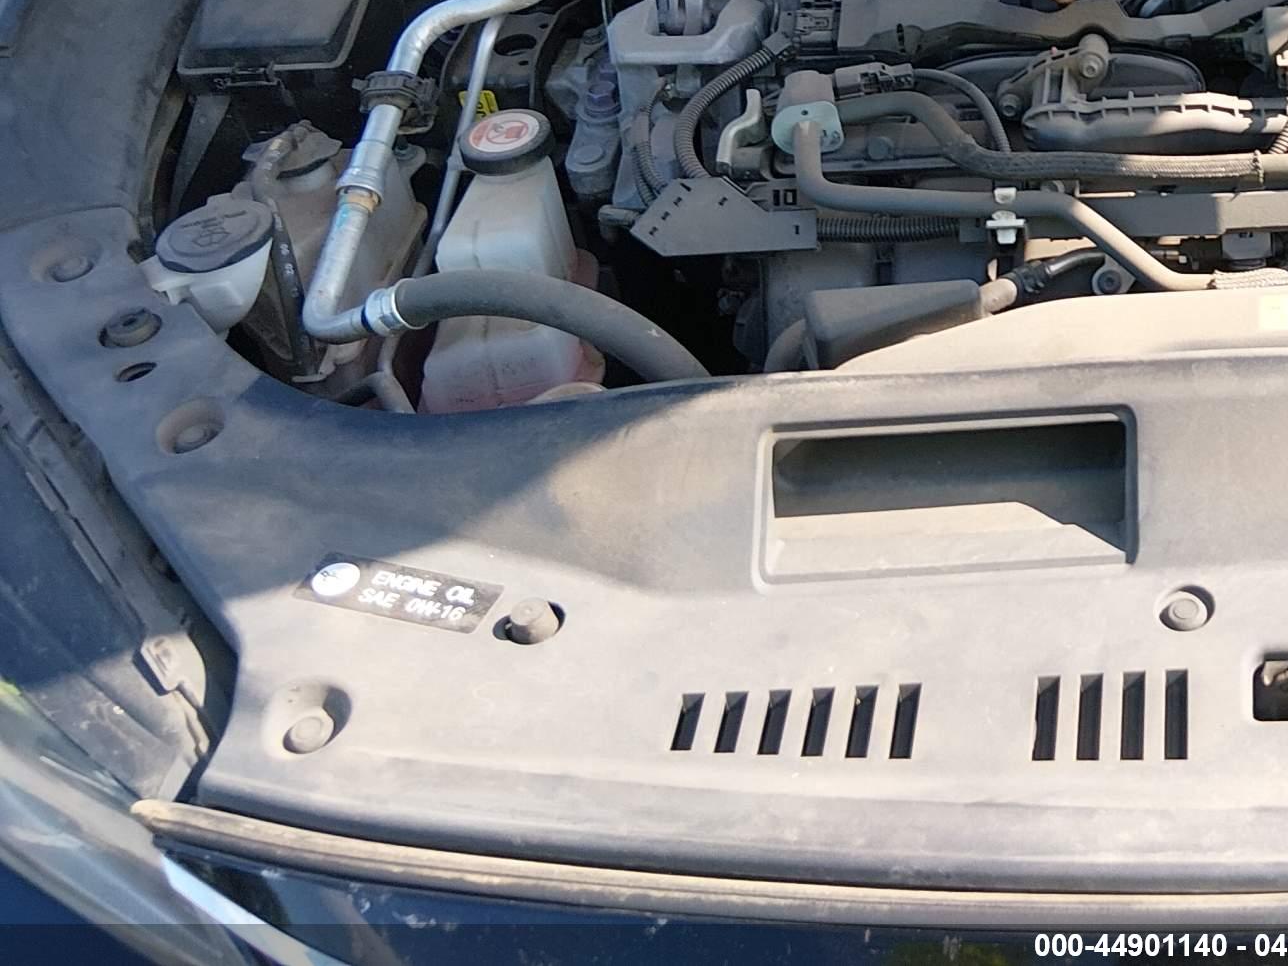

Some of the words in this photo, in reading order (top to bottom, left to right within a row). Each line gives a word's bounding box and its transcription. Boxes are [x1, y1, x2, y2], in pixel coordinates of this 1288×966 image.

[358, 588, 400, 609] SAE
[405, 598, 466, 620] 0W-16
[372, 570, 441, 596] ENGINE
[445, 585, 475, 606] OIL
